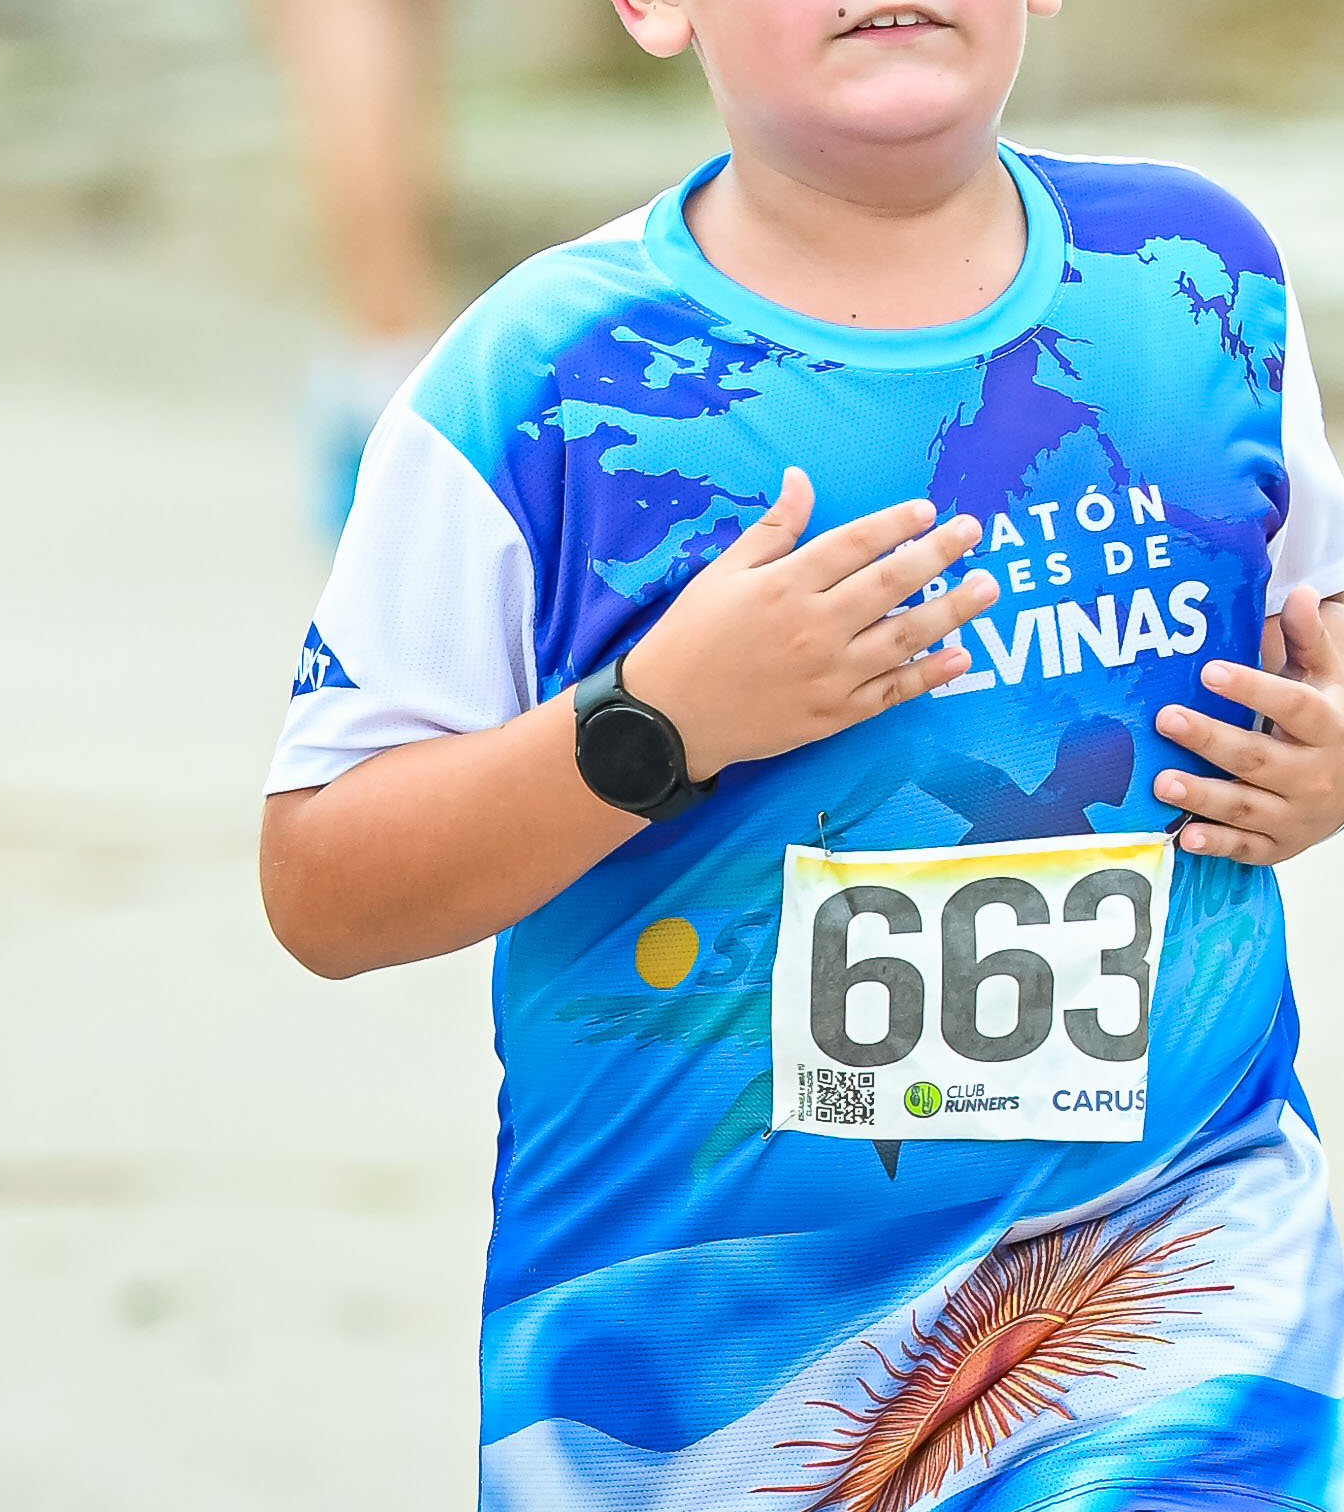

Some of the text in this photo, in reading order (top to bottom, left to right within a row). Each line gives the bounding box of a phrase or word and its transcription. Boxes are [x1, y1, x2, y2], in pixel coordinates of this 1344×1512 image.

[963, 485, 1167, 558] ATÓN
[1105, 535, 1172, 576] DE
[929, 580, 1211, 698] LVINAS
[809, 868, 1153, 1068] 663
[944, 1095, 1020, 1113] RUNNER'S
[946, 1083, 985, 1099] CLUB
